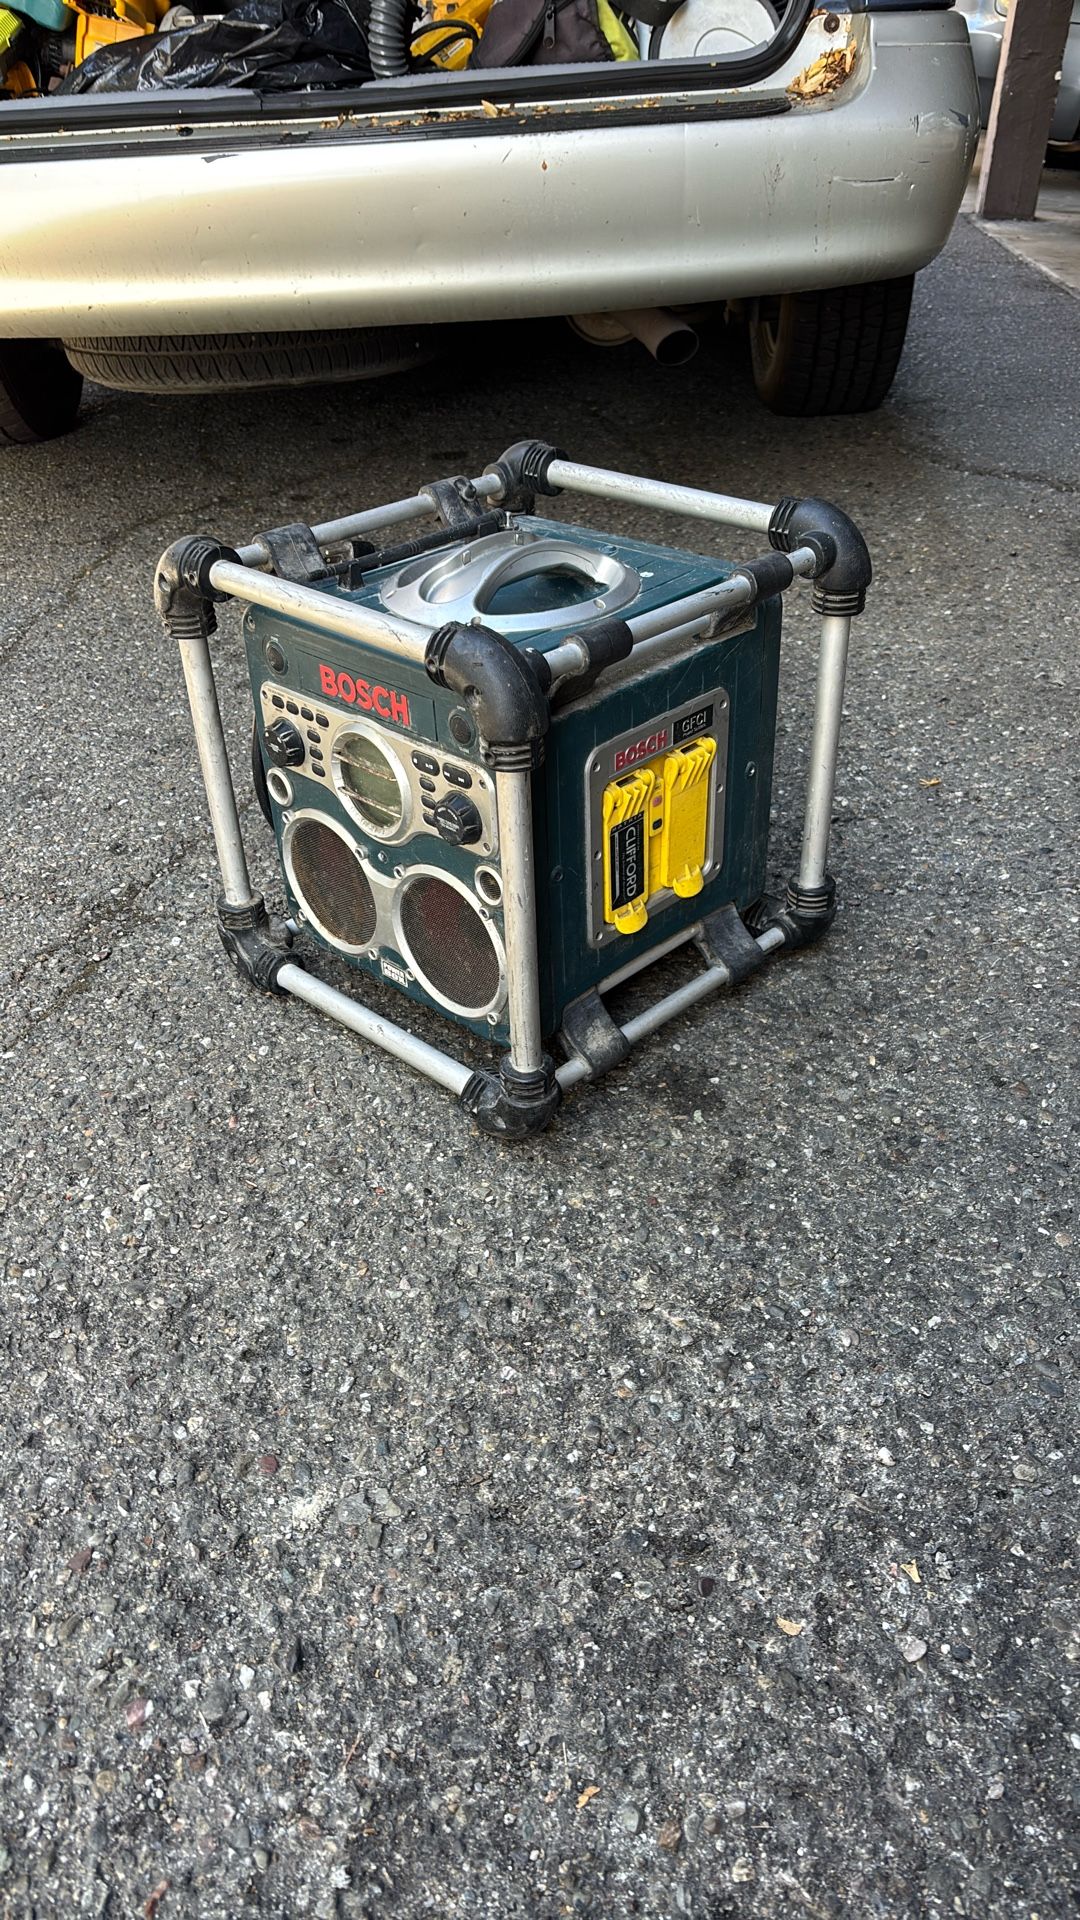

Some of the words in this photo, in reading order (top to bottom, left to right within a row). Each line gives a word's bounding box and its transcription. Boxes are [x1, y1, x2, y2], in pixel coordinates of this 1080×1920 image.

[319, 664, 410, 727] BOSCH
[682, 711, 707, 733] GFCI
[615, 729, 668, 772] BOSCH
[626, 826, 637, 897] CLIFFORD
